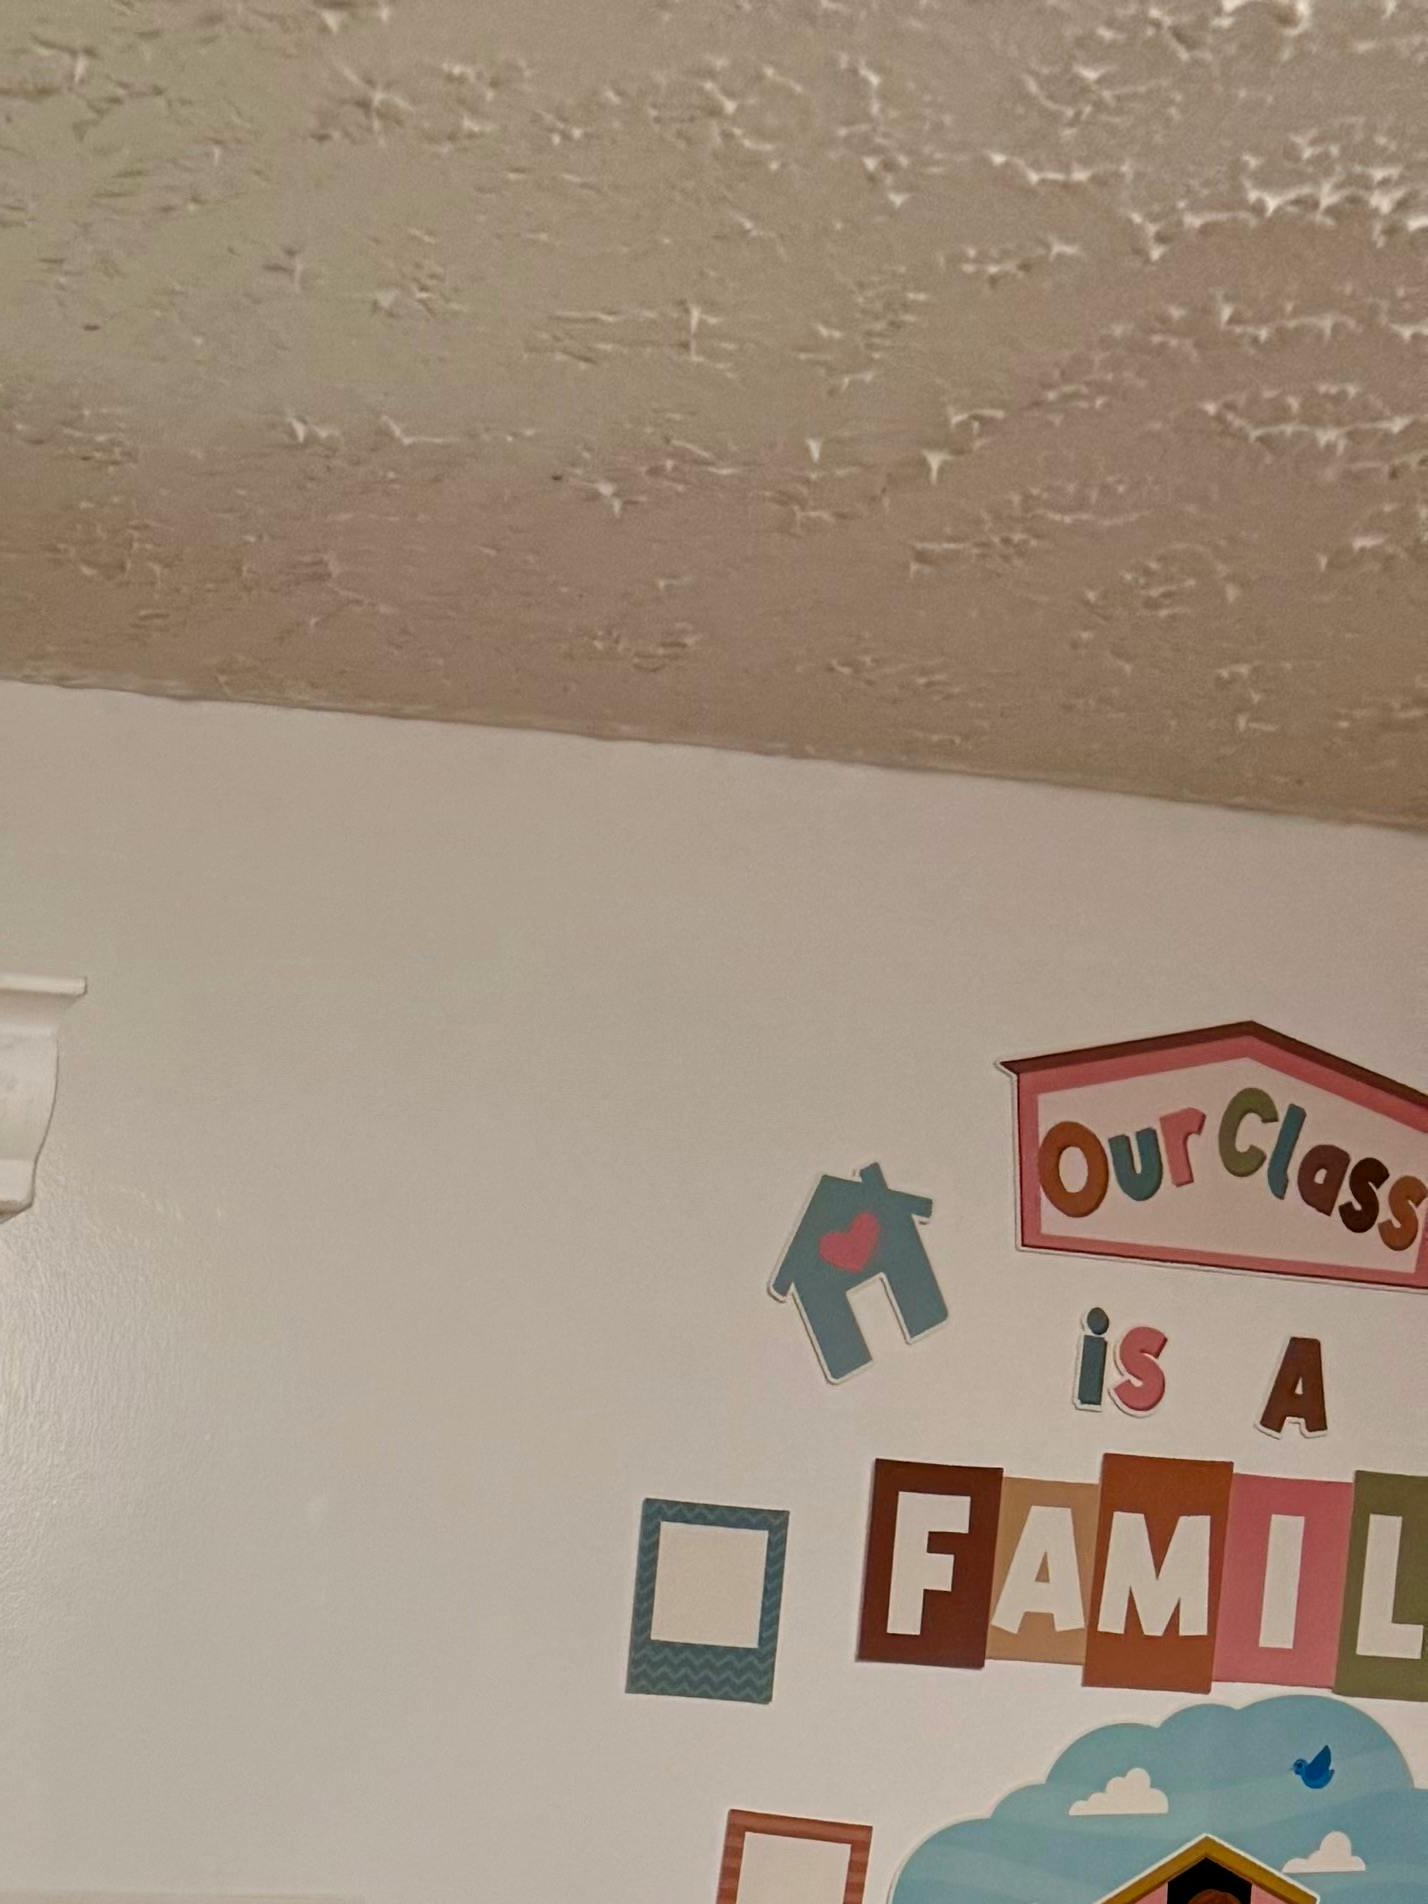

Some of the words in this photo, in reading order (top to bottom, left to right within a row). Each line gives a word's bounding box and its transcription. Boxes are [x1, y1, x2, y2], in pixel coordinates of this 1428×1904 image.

[1039, 1106, 1205, 1218] Our
[1218, 1087, 1427, 1251] Class
[1077, 1306, 1168, 1411] is
[1259, 1336, 1328, 1435] A
